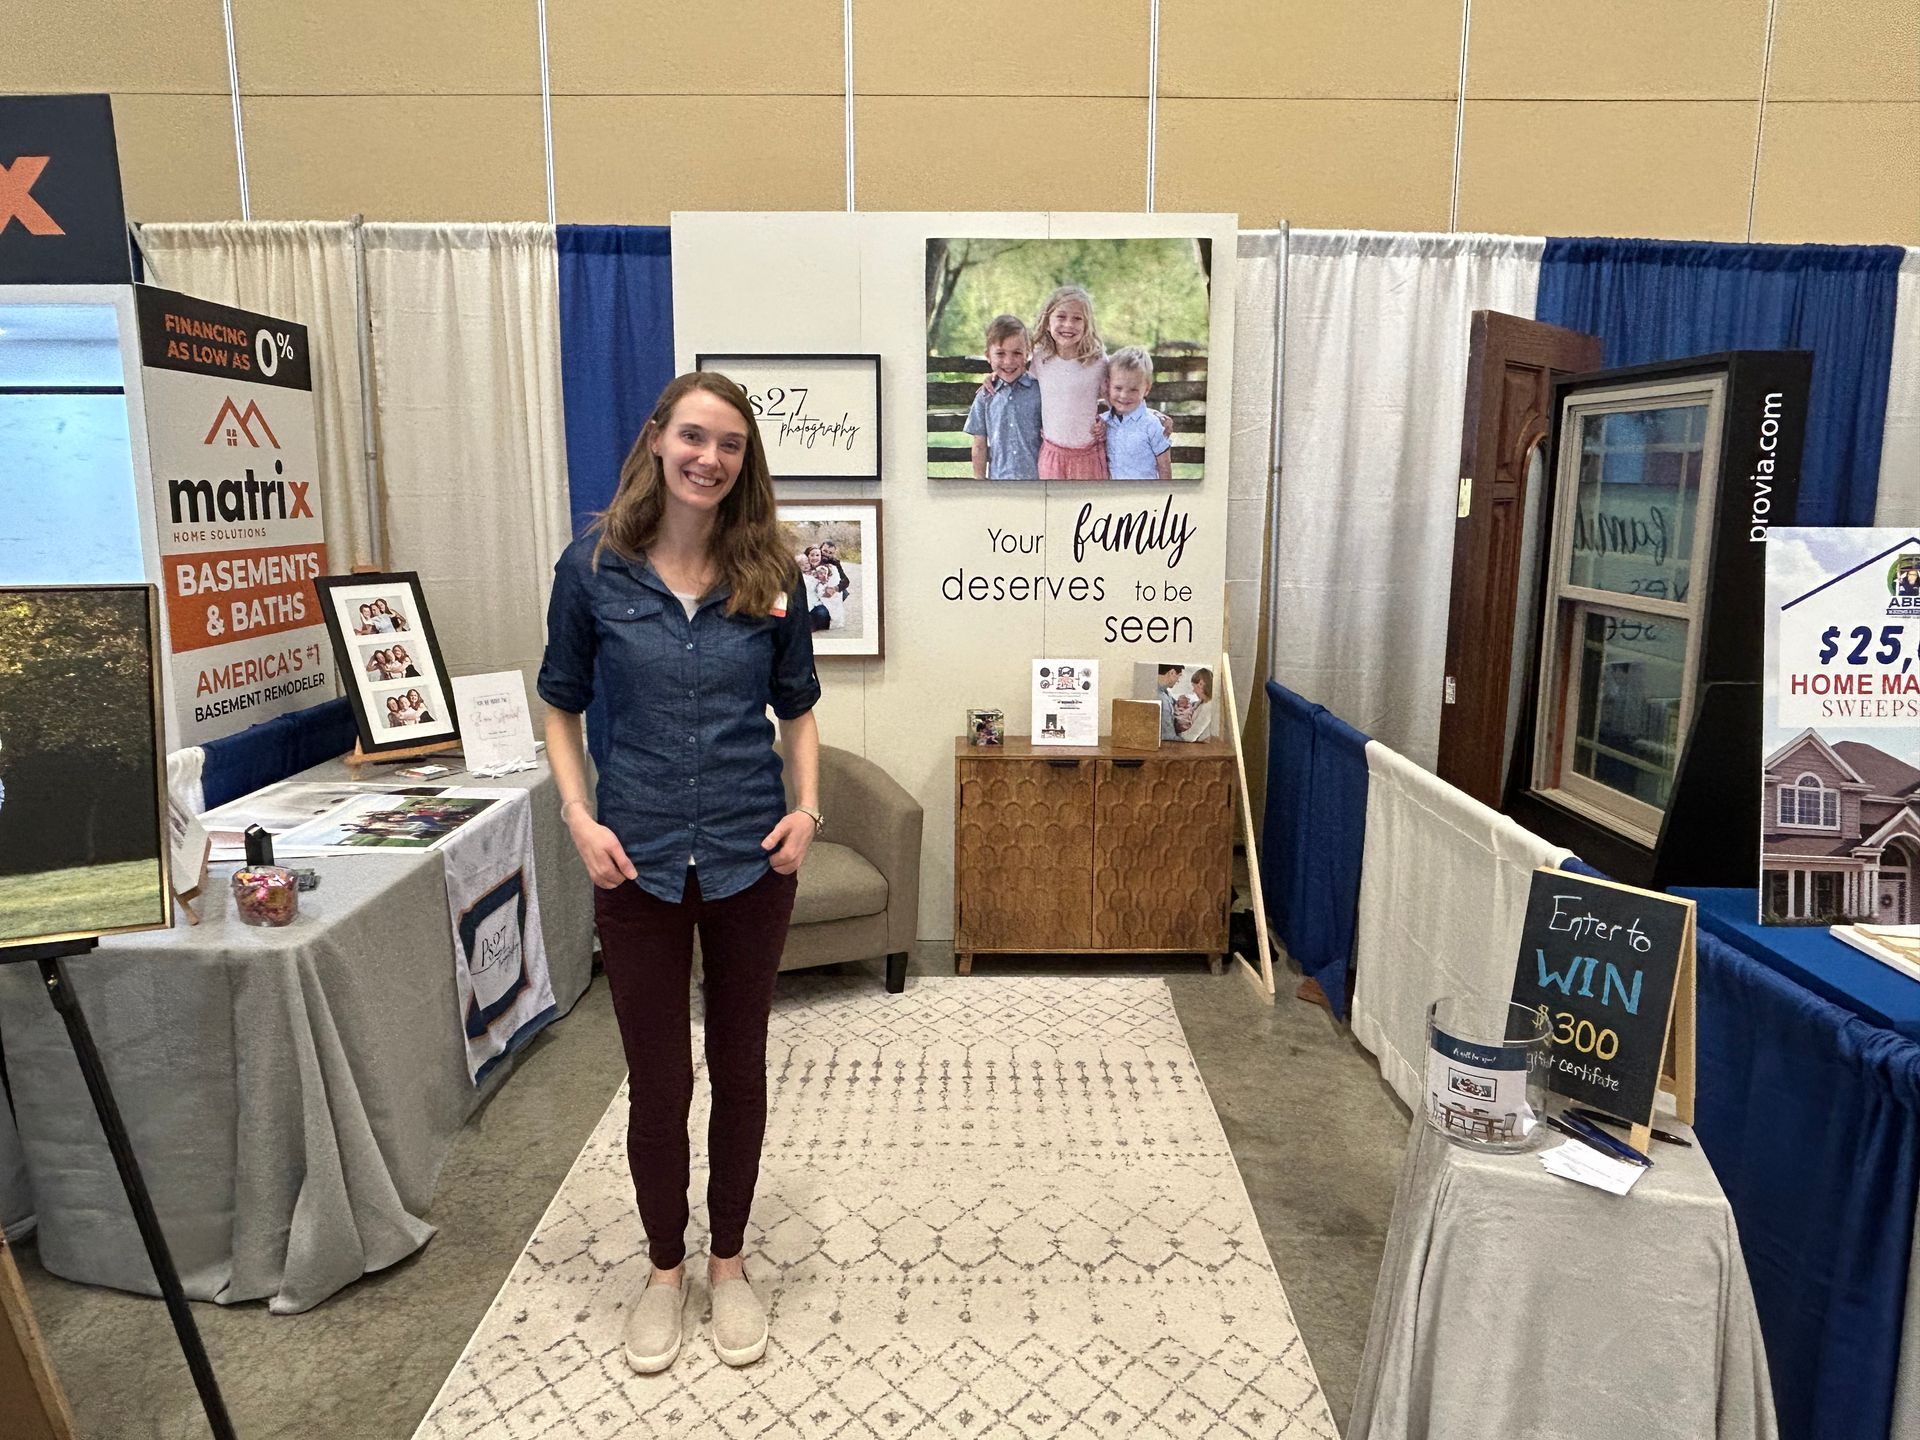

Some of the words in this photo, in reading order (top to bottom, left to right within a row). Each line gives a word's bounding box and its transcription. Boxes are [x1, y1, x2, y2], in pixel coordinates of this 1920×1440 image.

[164, 313, 248, 347] FINANCING
[255, 328, 294, 377] 0%
[167, 340, 190, 360] AS
[192, 343, 228, 367] LOW
[232, 352, 251, 371] AS
[779, 412, 860, 451] photography
[1750, 392, 1783, 542] provia.com
[168, 459, 314, 523] matrix
[173, 531, 206, 543] HOME
[210, 527, 267, 541] SOLUTIONS
[988, 528, 1044, 554] Your
[1073, 494, 1198, 568] family
[176, 552, 320, 597] BASEMENTS
[942, 568, 1105, 601] deserves
[1135, 580, 1156, 602] to
[1164, 580, 1192, 602] be
[206, 604, 225, 637] &
[231, 591, 305, 632] BATHS
[1104, 615, 1193, 643] seen
[196, 648, 303, 698] AMERICA'S
[306, 643, 321, 666] #1
[1819, 625, 1920, 674] $25,
[195, 691, 262, 723] BASEMENT
[264, 672, 326, 703] REMODELER
[1792, 674, 1873, 695] HOME
[1882, 674, 1920, 695] MA
[1822, 699, 1919, 718] SWEEPS
[1549, 895, 1622, 941] Enter
[1627, 918, 1651, 952] to
[1536, 948, 1643, 1015] WIN
[1532, 1004, 1619, 1060] $300
